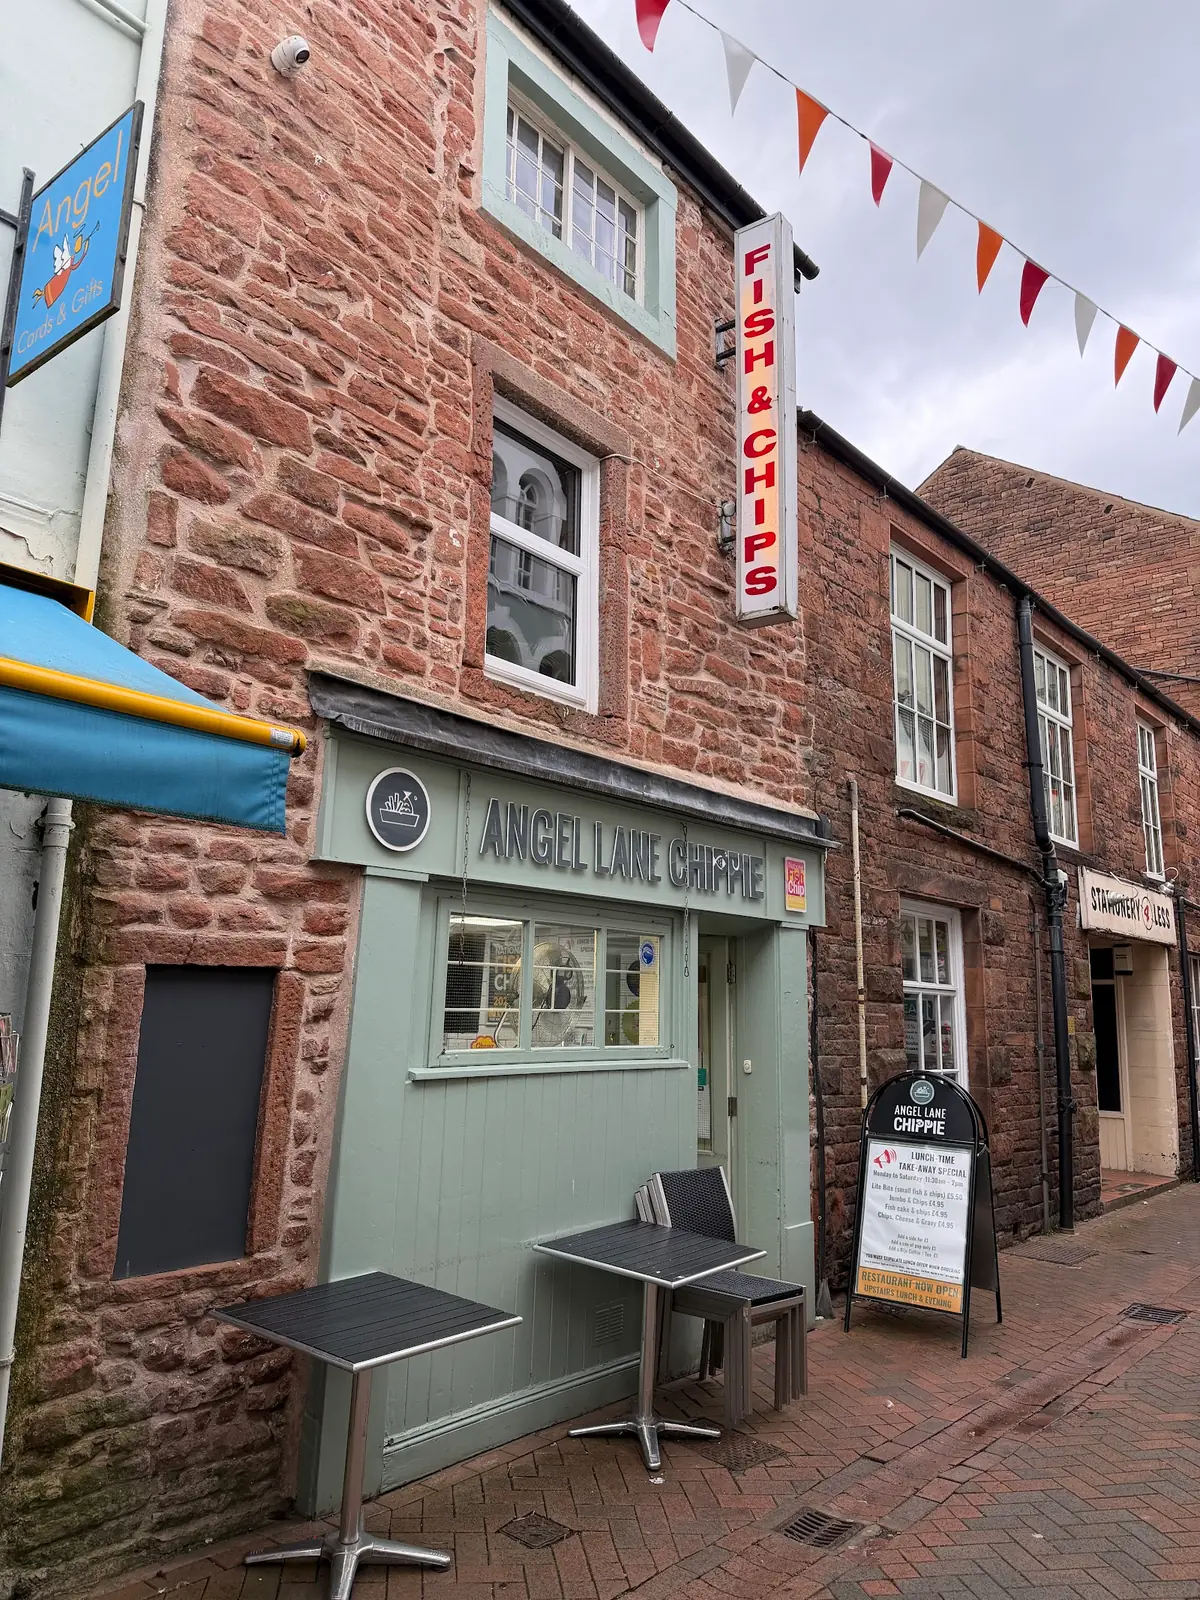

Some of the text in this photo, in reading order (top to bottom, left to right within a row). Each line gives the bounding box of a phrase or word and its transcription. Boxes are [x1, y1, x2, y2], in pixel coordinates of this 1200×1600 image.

[32, 129, 123, 253] Angel
[18, 278, 103, 354] Cards & Gifts
[743, 243, 777, 597] FISH & CHIPS
[479, 798, 765, 899] ANGEL LANE CHIPPIE
[1153, 904, 1171, 929] LESS
[894, 1105, 947, 1120] ANGEL LANE
[893, 1117, 946, 1135] CHIPPIE
[873, 1170, 892, 1179] Monday
[899, 1173, 923, 1183] Saturday
[899, 1162, 967, 1179] TAKE-AWAY SPECIAL
[912, 1187, 923, 1196] fish
[889, 1194, 907, 1203] Jumbo
[912, 1197, 928, 1207] Chips
[928, 1200, 945, 1208] £4.95
[885, 1203, 896, 1211] Fish
[931, 1210, 948, 1219] £4.95
[895, 1214, 915, 1223] Cheese
[921, 1218, 937, 1228] Gravy
[937, 1220, 954, 1230] £4.95
[861, 1270, 913, 1289] RESTAURANT
[914, 1281, 934, 1293] NOW
[935, 1285, 959, 1298] OPEN
[864, 1284, 895, 1297] UPSTAIRS
[896, 1289, 917, 1301] LUNCH
[925, 1294, 952, 1308] EVENING
